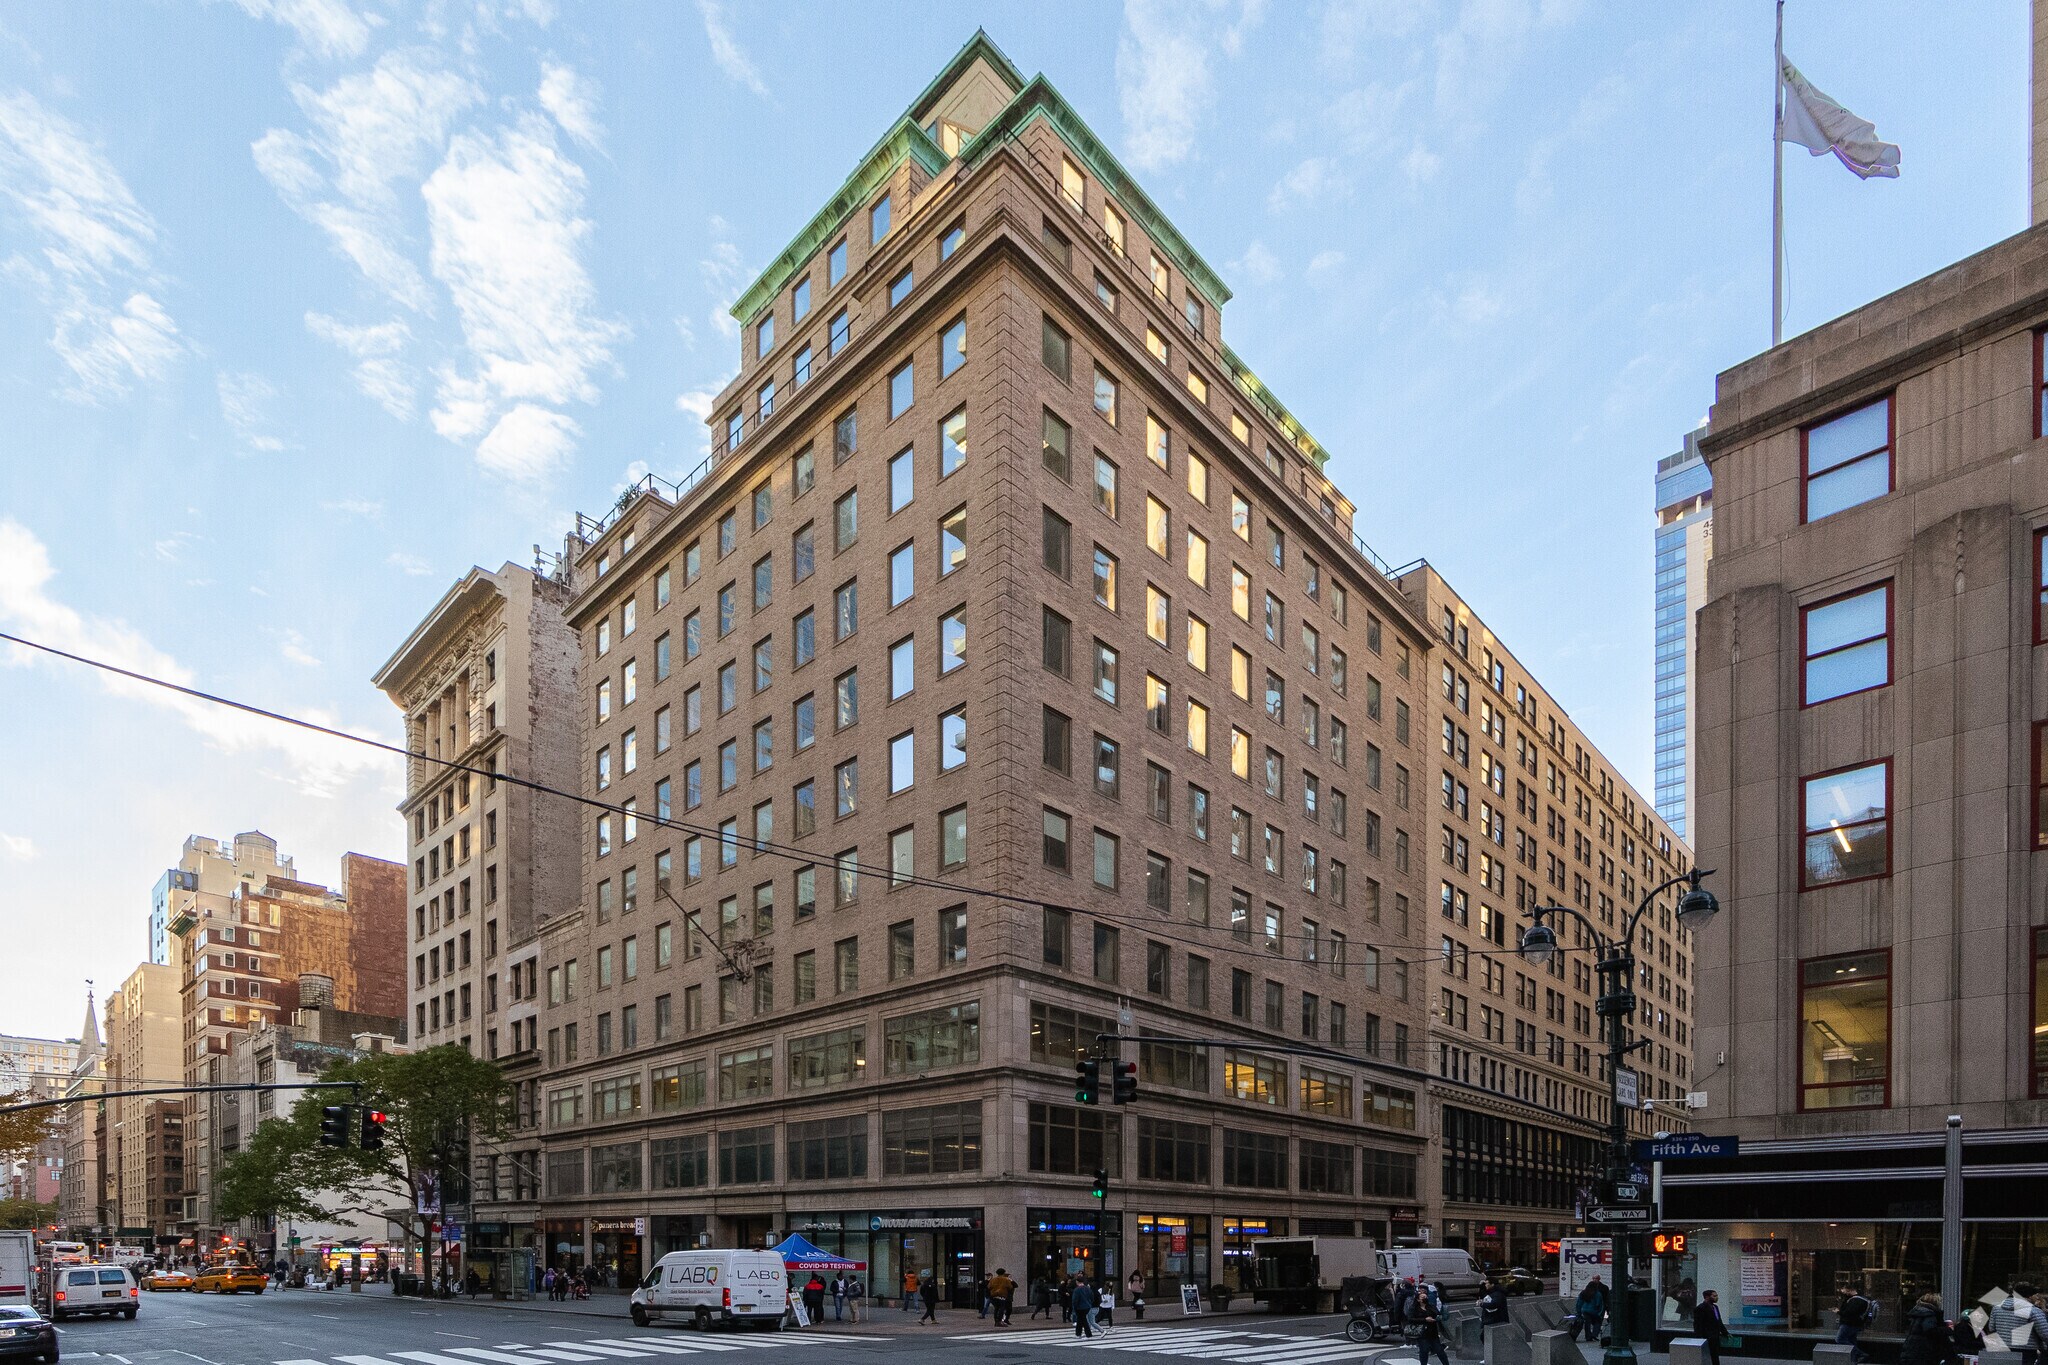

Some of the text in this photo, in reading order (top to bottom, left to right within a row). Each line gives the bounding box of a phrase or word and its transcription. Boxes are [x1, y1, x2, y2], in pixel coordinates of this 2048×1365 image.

[1652, 1143, 1720, 1155] Fifth Ave
[1621, 1210, 1641, 1218] WAY
[620, 1221, 635, 1229] brea
[906, 1218, 943, 1228] AMERICA
[1673, 1235, 1684, 1251] 12
[1564, 1249, 1612, 1264] FedE
[669, 1266, 718, 1286] LABQ
[737, 1270, 780, 1281] LABQ
